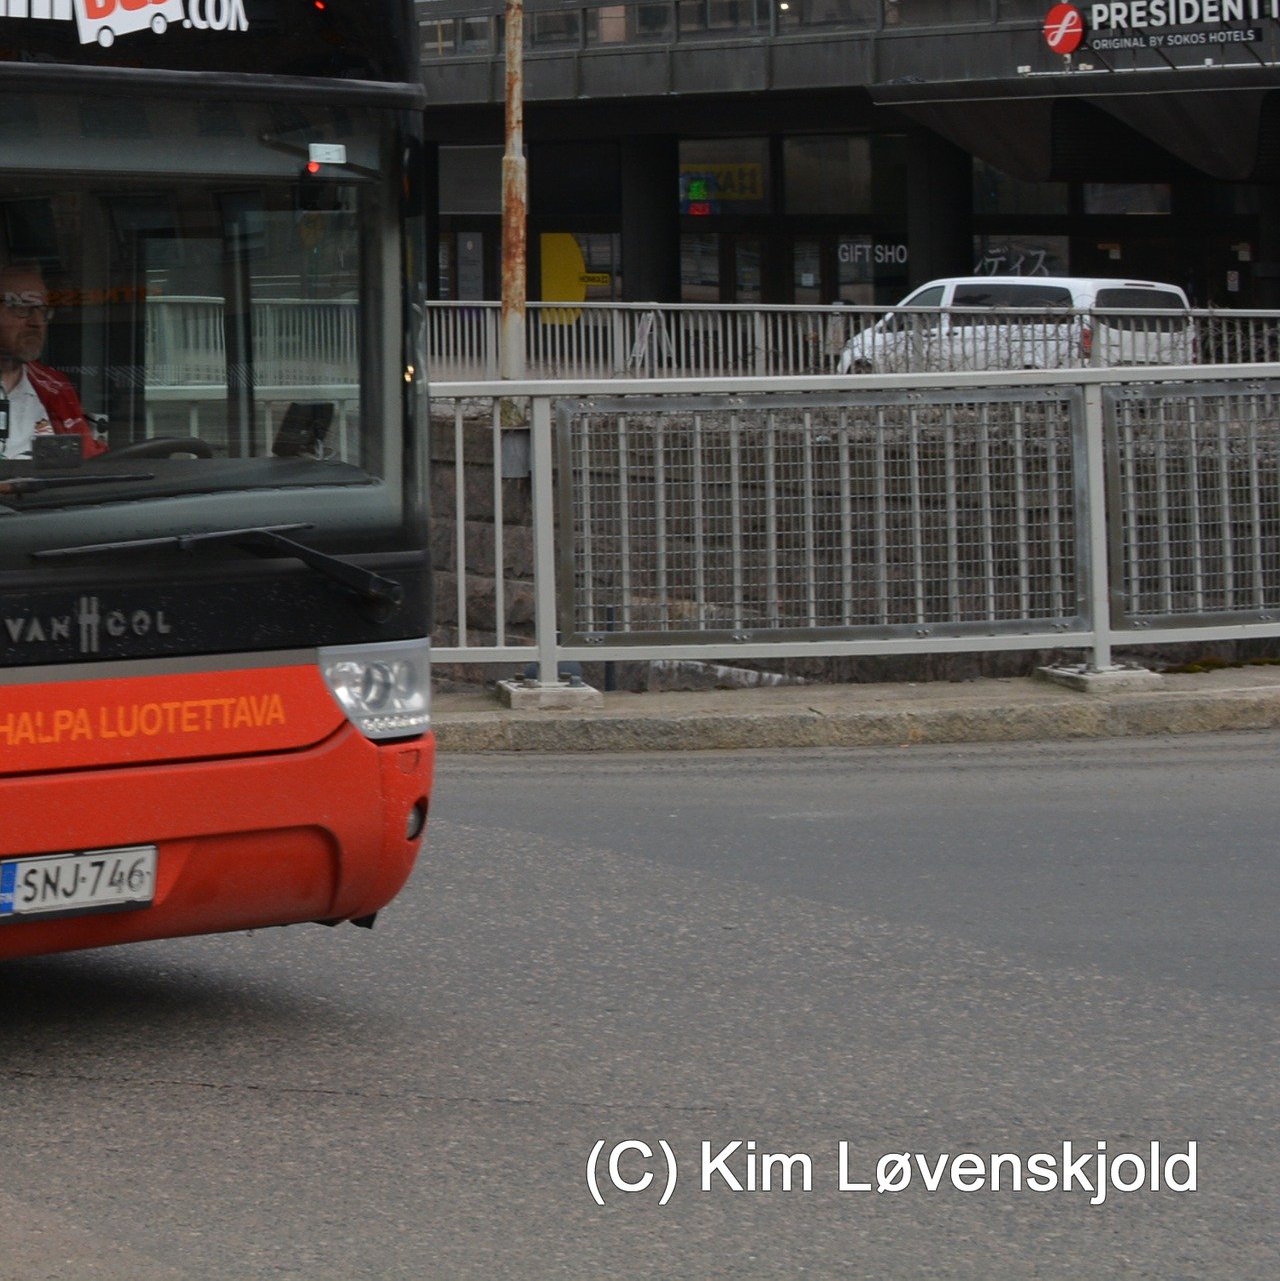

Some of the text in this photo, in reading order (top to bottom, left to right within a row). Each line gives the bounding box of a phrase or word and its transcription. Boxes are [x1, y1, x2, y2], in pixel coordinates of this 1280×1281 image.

[1093, 29, 1255, 51] ORIGINAL BY SOKOS HOTELS
[838, 244, 908, 264] GIFT SHO
[974, 245, 1050, 276] ディス
[100, 694, 285, 738] LUOTETTAVA
[22, 857, 145, 902] SNJ-746
